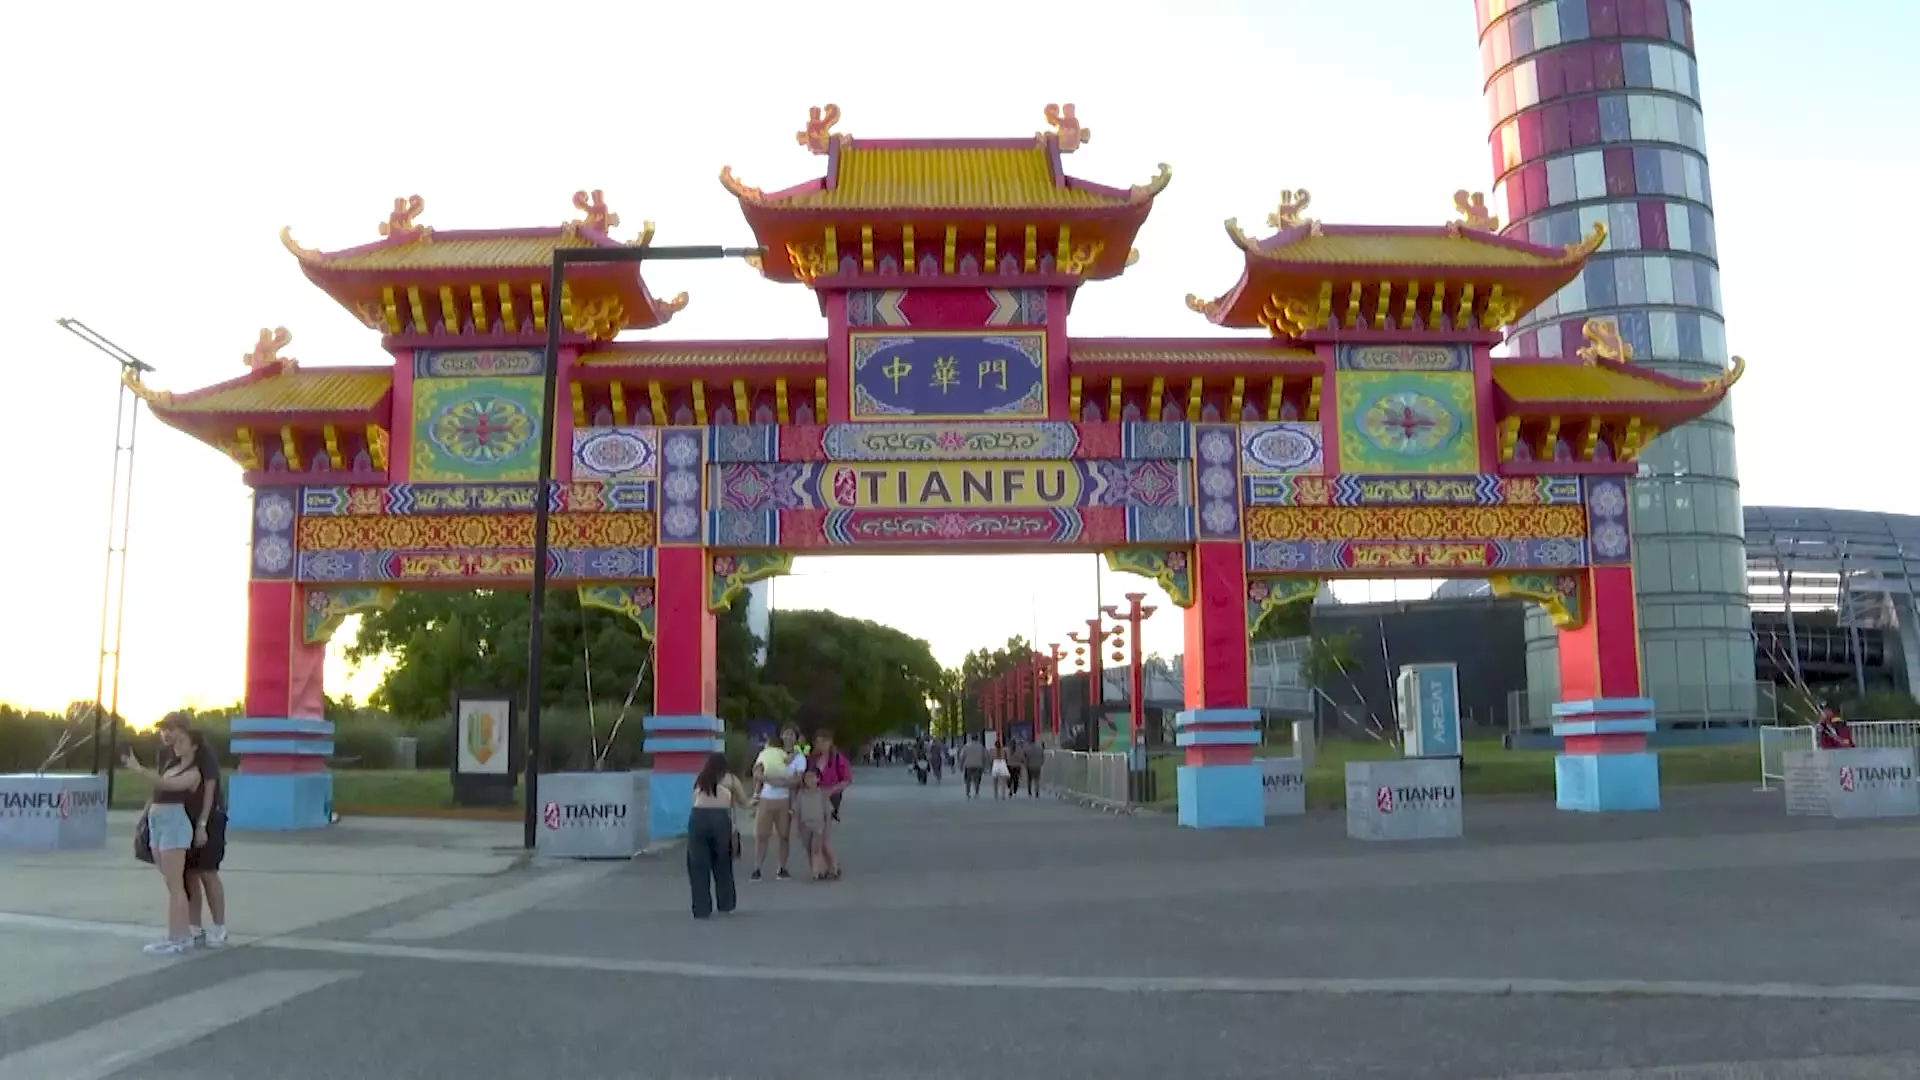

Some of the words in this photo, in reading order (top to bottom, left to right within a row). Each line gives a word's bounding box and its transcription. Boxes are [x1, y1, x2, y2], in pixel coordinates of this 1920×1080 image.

[882, 355, 1008, 394] 中華門
[860, 468, 1066, 505] TIANFU
[1430, 680, 1446, 745] ARSAT
[1262, 774, 1304, 787] IANFU
[1855, 766, 1912, 781] TIANFU
[1395, 785, 1455, 802] TIANFU
[563, 803, 627, 819] TIANFU
